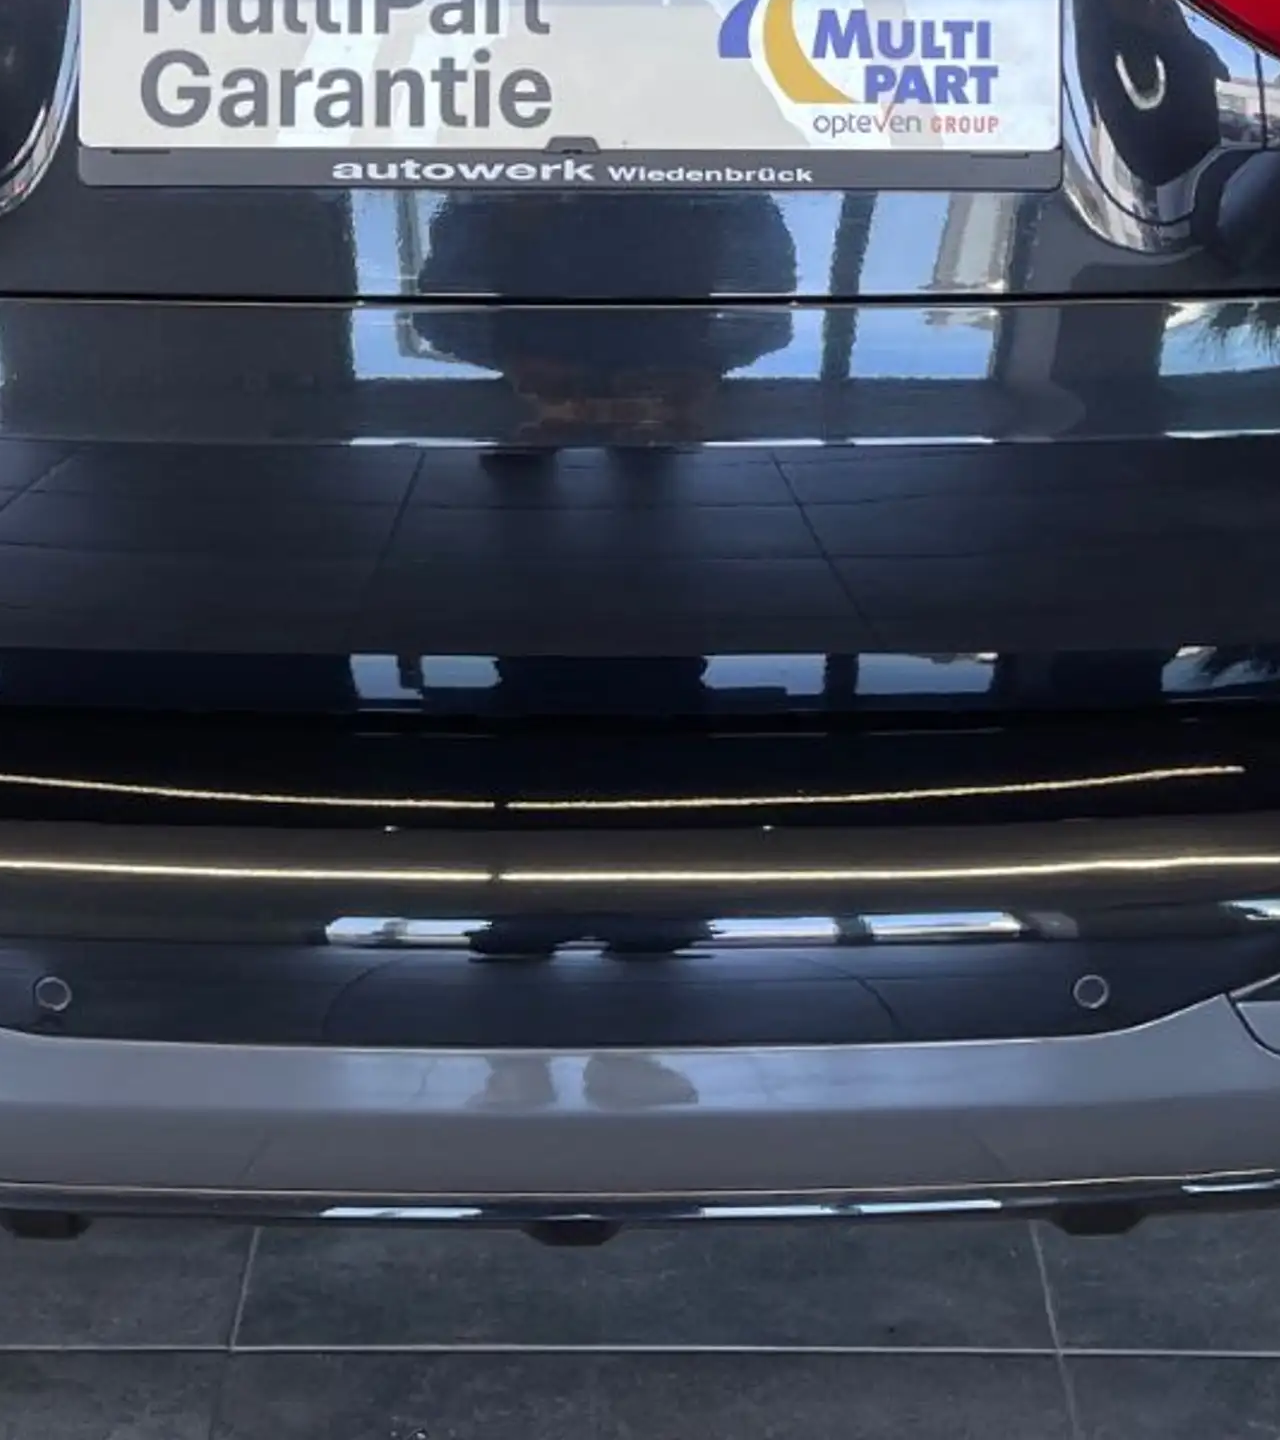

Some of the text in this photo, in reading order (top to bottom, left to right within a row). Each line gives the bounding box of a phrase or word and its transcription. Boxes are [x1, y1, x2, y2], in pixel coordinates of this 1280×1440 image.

[812, 9, 992, 59] MULTI
[140, 49, 553, 129] Garantie
[864, 65, 999, 104] PART
[813, 106, 1000, 137] opteven GROUP
[332, 160, 813, 183] autowerk Wiedenbrück
